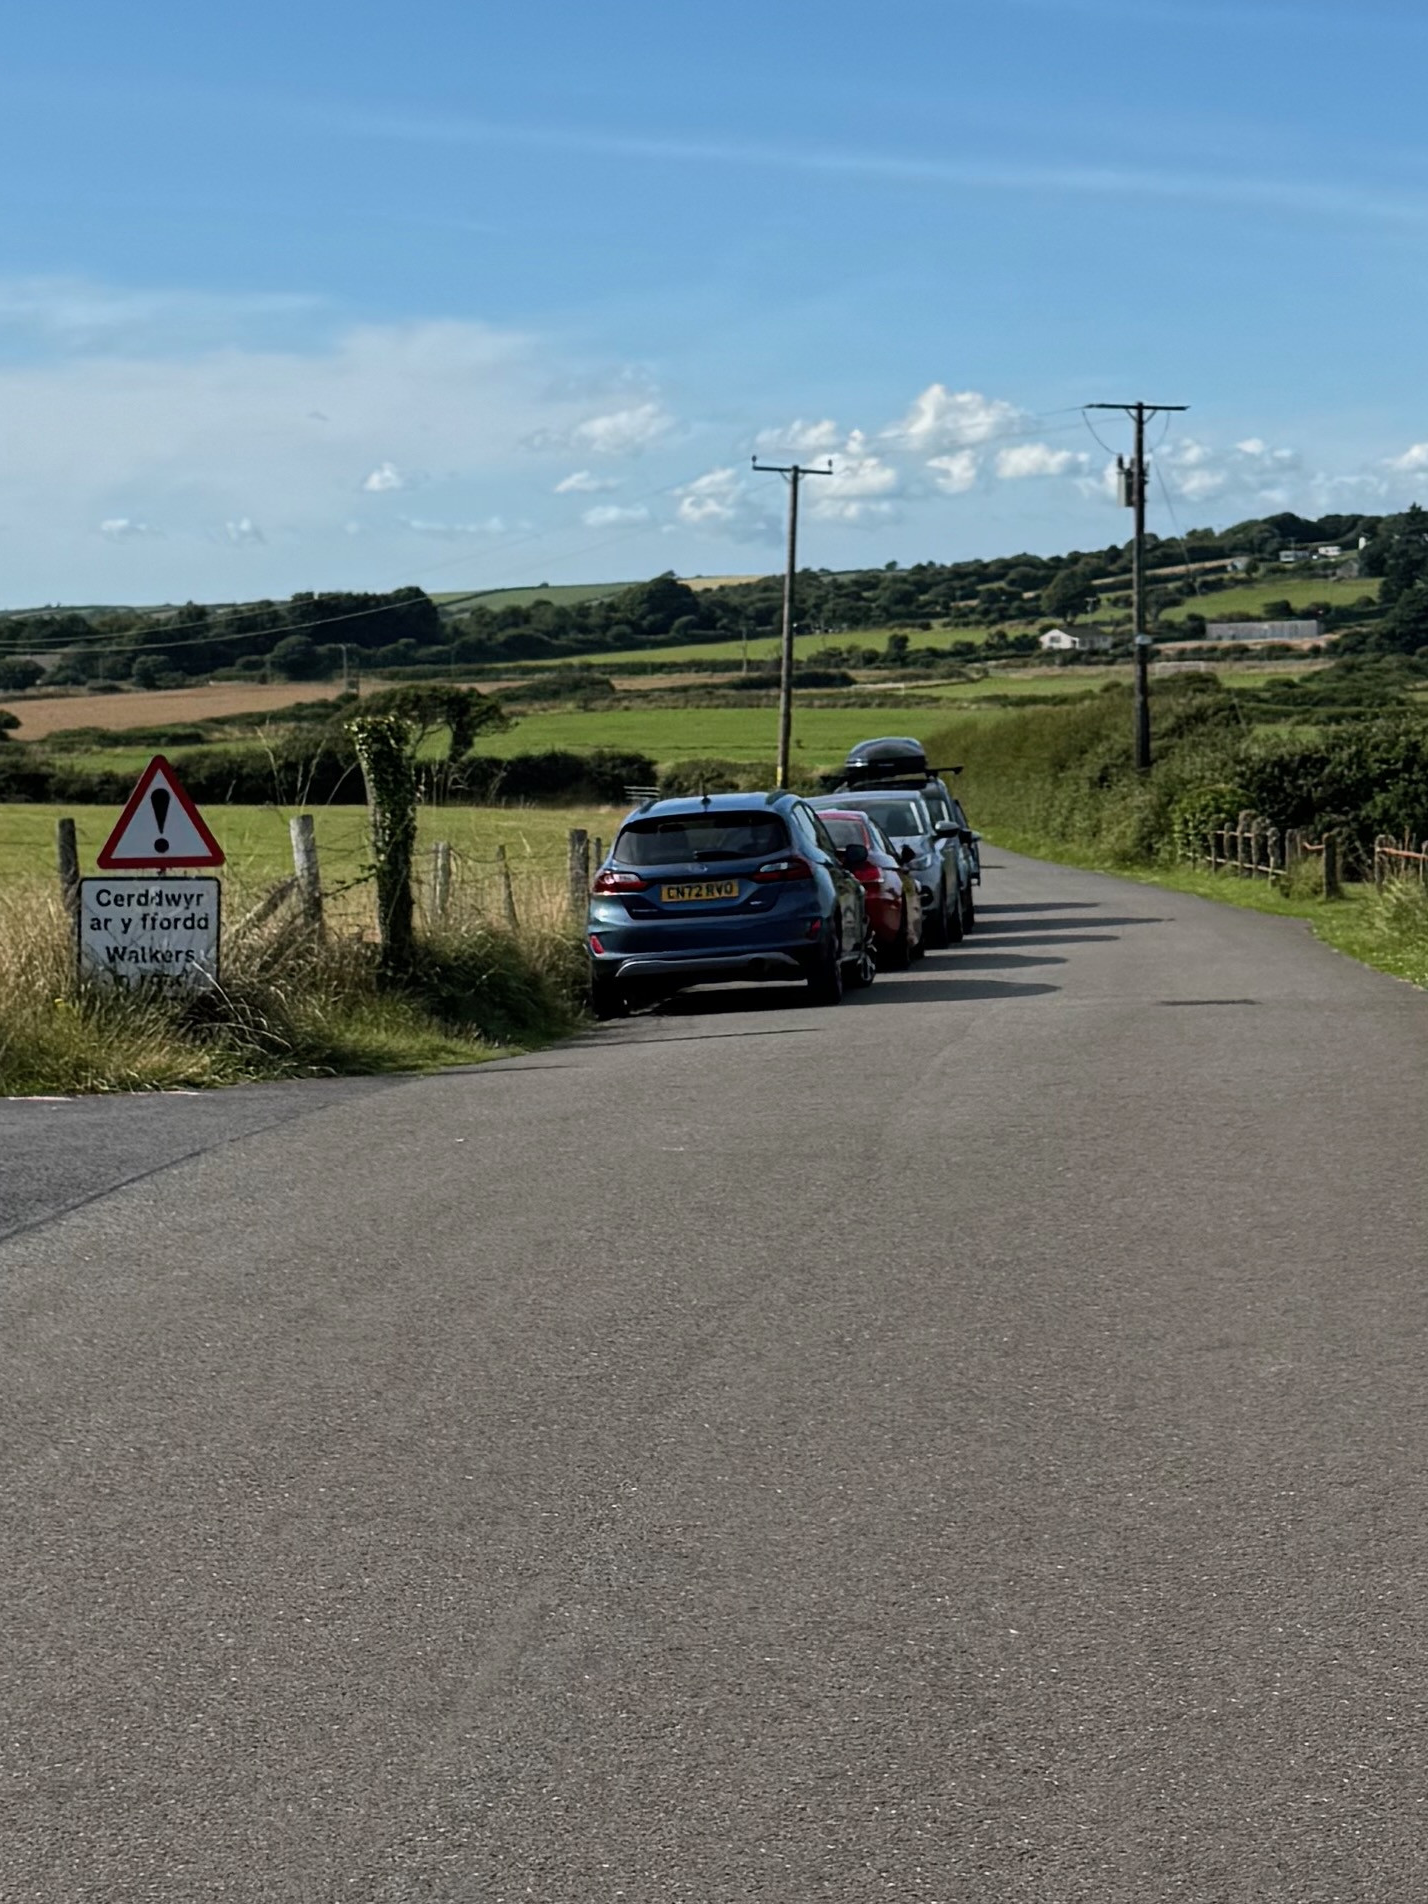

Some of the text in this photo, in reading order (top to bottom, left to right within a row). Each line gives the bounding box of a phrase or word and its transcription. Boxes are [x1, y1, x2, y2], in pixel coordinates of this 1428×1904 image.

[96, 889, 204, 910] Cerddwyr
[90, 912, 209, 934] ar y ffordd
[105, 946, 195, 963] Walkers
